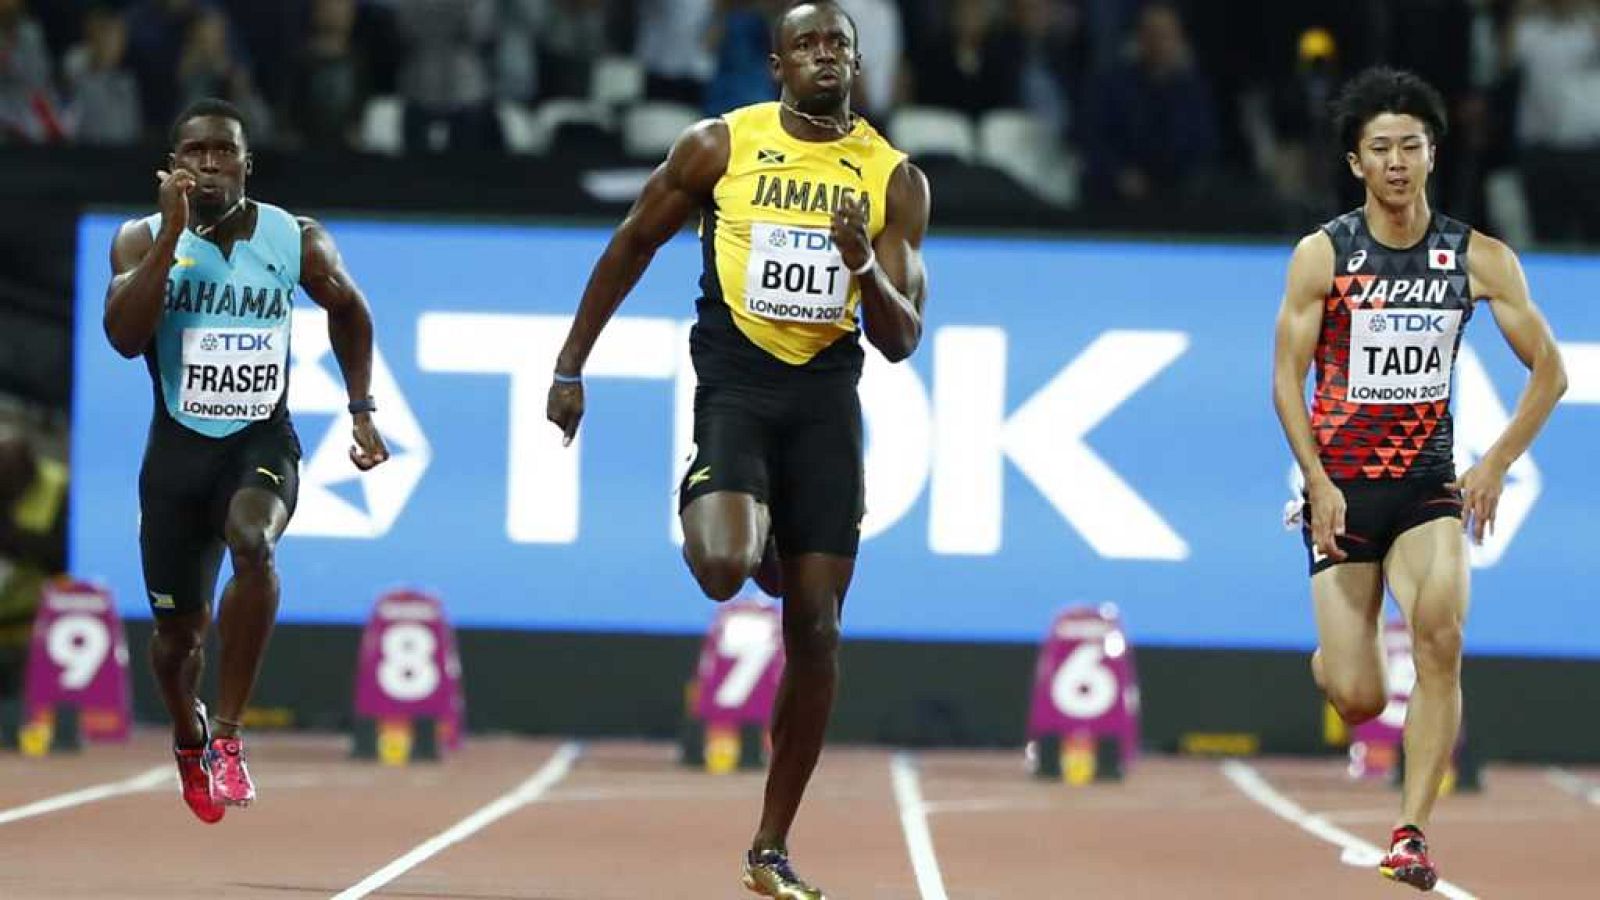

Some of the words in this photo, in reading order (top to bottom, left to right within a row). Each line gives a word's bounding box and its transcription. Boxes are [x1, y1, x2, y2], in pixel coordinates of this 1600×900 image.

[788, 230, 834, 251] TD
[762, 260, 840, 295] BOLT
[1352, 278, 1448, 304] JAPAN
[749, 299, 813, 319] LONDON
[1387, 314, 1445, 332] TDK
[218, 332, 273, 351] TDK
[1362, 346, 1442, 376] TADA
[186, 364, 279, 393] FRASER
[1351, 386, 1418, 400] LONDON
[1420, 383, 1446, 400] 2017
[183, 400, 248, 417] LONDON
[47, 615, 109, 690] 9
[377, 622, 440, 700] 8
[714, 622, 777, 708] 7
[1052, 644, 1117, 718] 6
